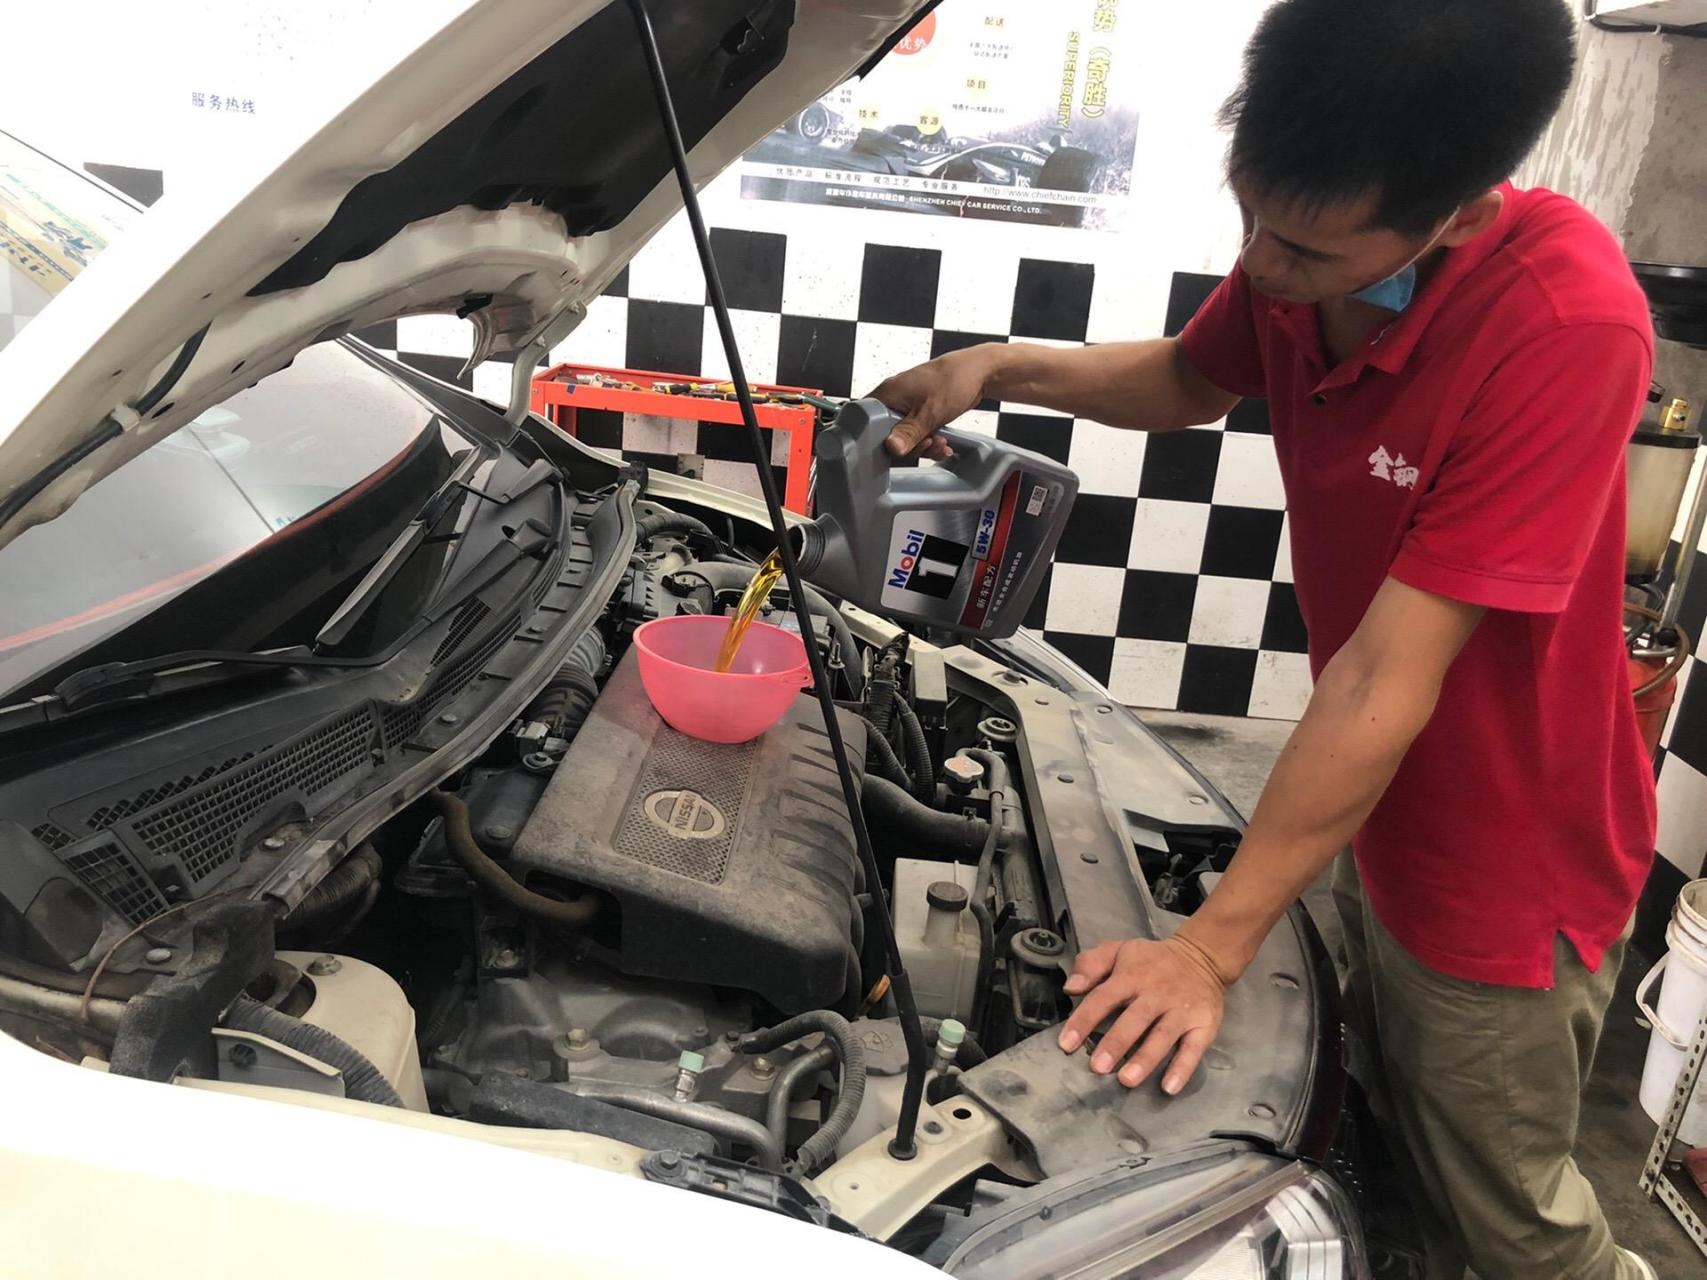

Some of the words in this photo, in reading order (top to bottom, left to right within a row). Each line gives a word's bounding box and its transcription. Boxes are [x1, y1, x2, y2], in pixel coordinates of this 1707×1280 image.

[966, 79, 986, 90] 项目
[1057, 31, 1080, 128] SUPERIORITY
[192, 91, 256, 115] 服务热线
[909, 196, 944, 205] SHENZHEN
[966, 201, 982, 209] CAR
[982, 203, 1011, 212] SERVICE
[975, 510, 996, 555] 5W-30
[887, 529, 925, 589] Mobil
[917, 556, 960, 579] 1
[675, 795, 696, 830] NISSAN
